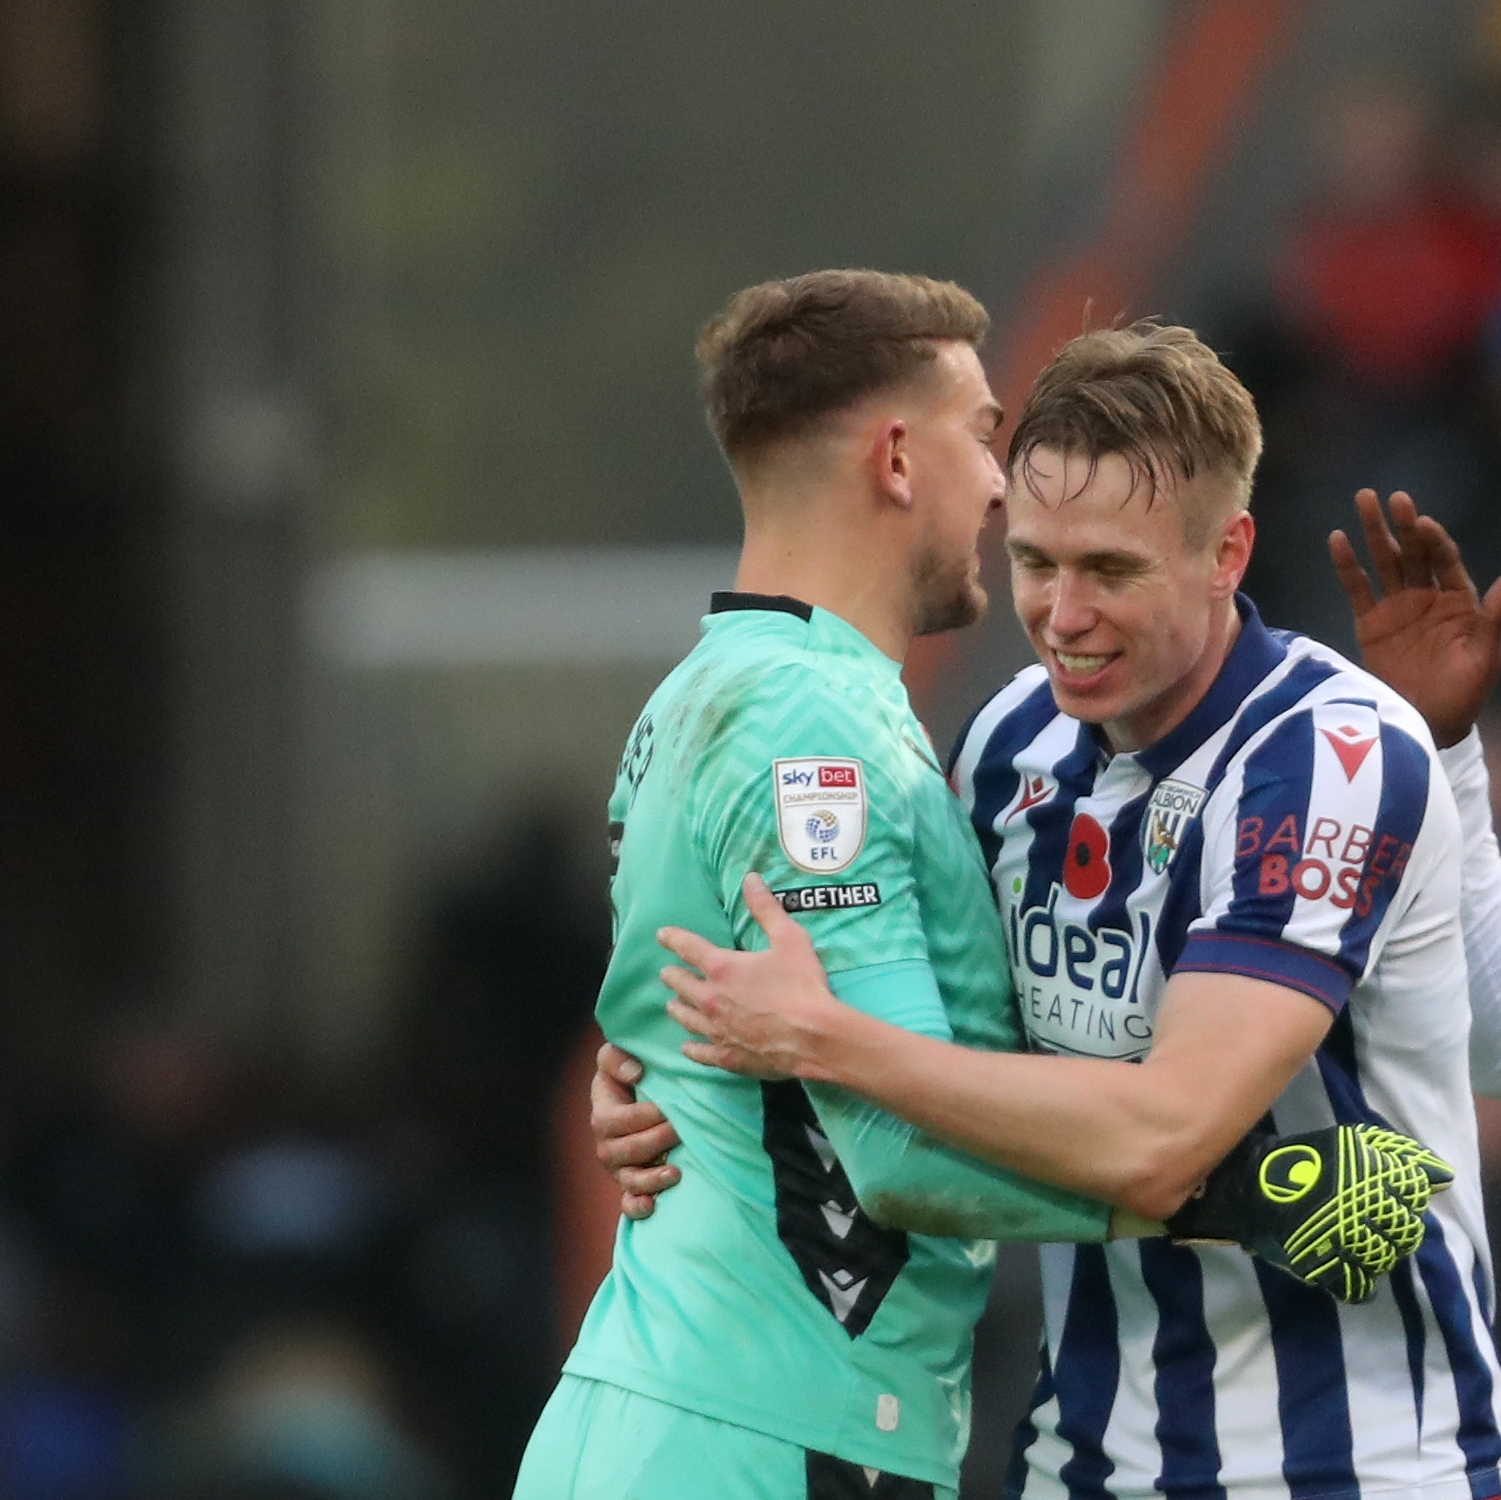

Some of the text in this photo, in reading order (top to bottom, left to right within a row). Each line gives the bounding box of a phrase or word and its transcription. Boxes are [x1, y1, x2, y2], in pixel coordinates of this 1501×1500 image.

[782, 767, 853, 786] sky bet
[784, 791, 859, 804] CHAMPIONSHIP
[1150, 791, 1199, 814] ALBION
[810, 846, 838, 861] EFL
[1236, 814, 1412, 880] BARBER
[1257, 853, 1381, 918] BOSS
[1010, 876, 1151, 1003] ideal
